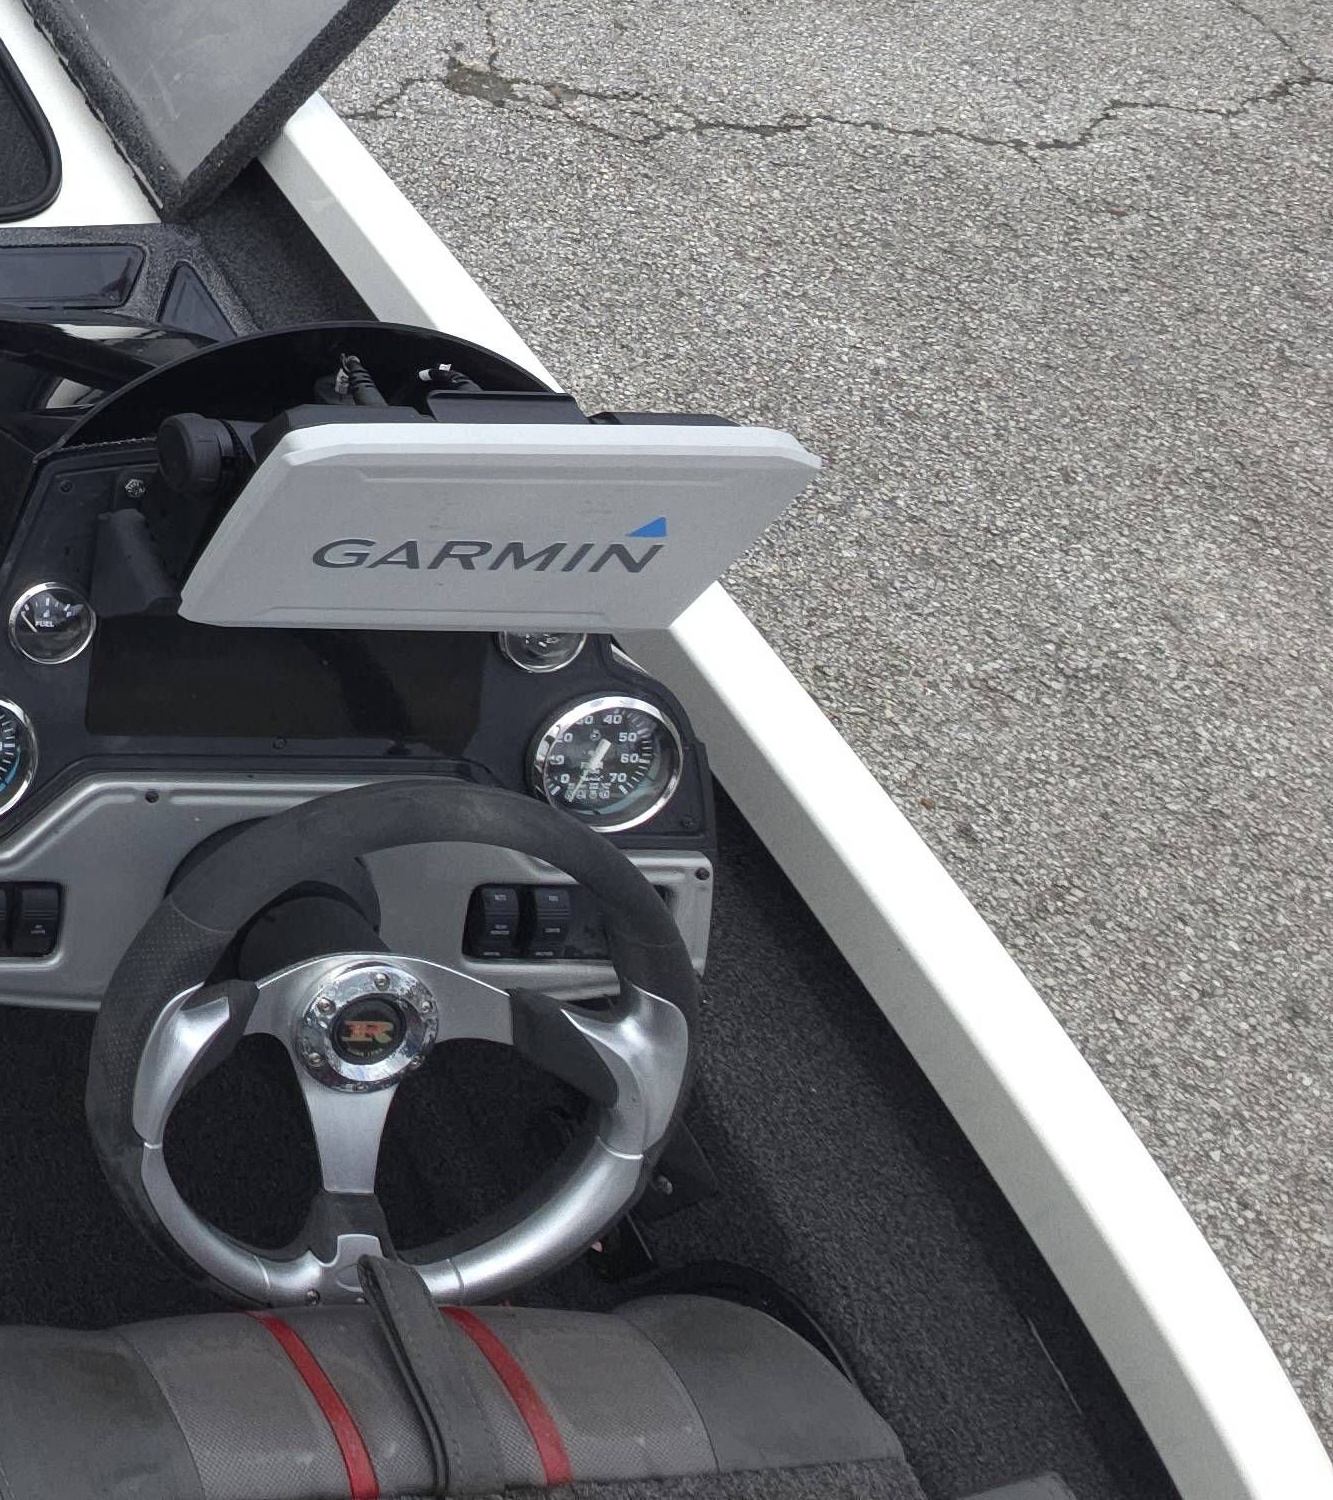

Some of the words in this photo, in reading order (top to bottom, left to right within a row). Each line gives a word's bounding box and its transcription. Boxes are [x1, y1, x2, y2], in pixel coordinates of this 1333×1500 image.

[311, 538, 665, 573] GARMIN
[35, 620, 55, 628] FUEL
[603, 714, 623, 725] 40
[619, 732, 637, 742] 50
[620, 753, 639, 764] 60
[560, 773, 570, 784] 0
[609, 772, 627, 783] 70
